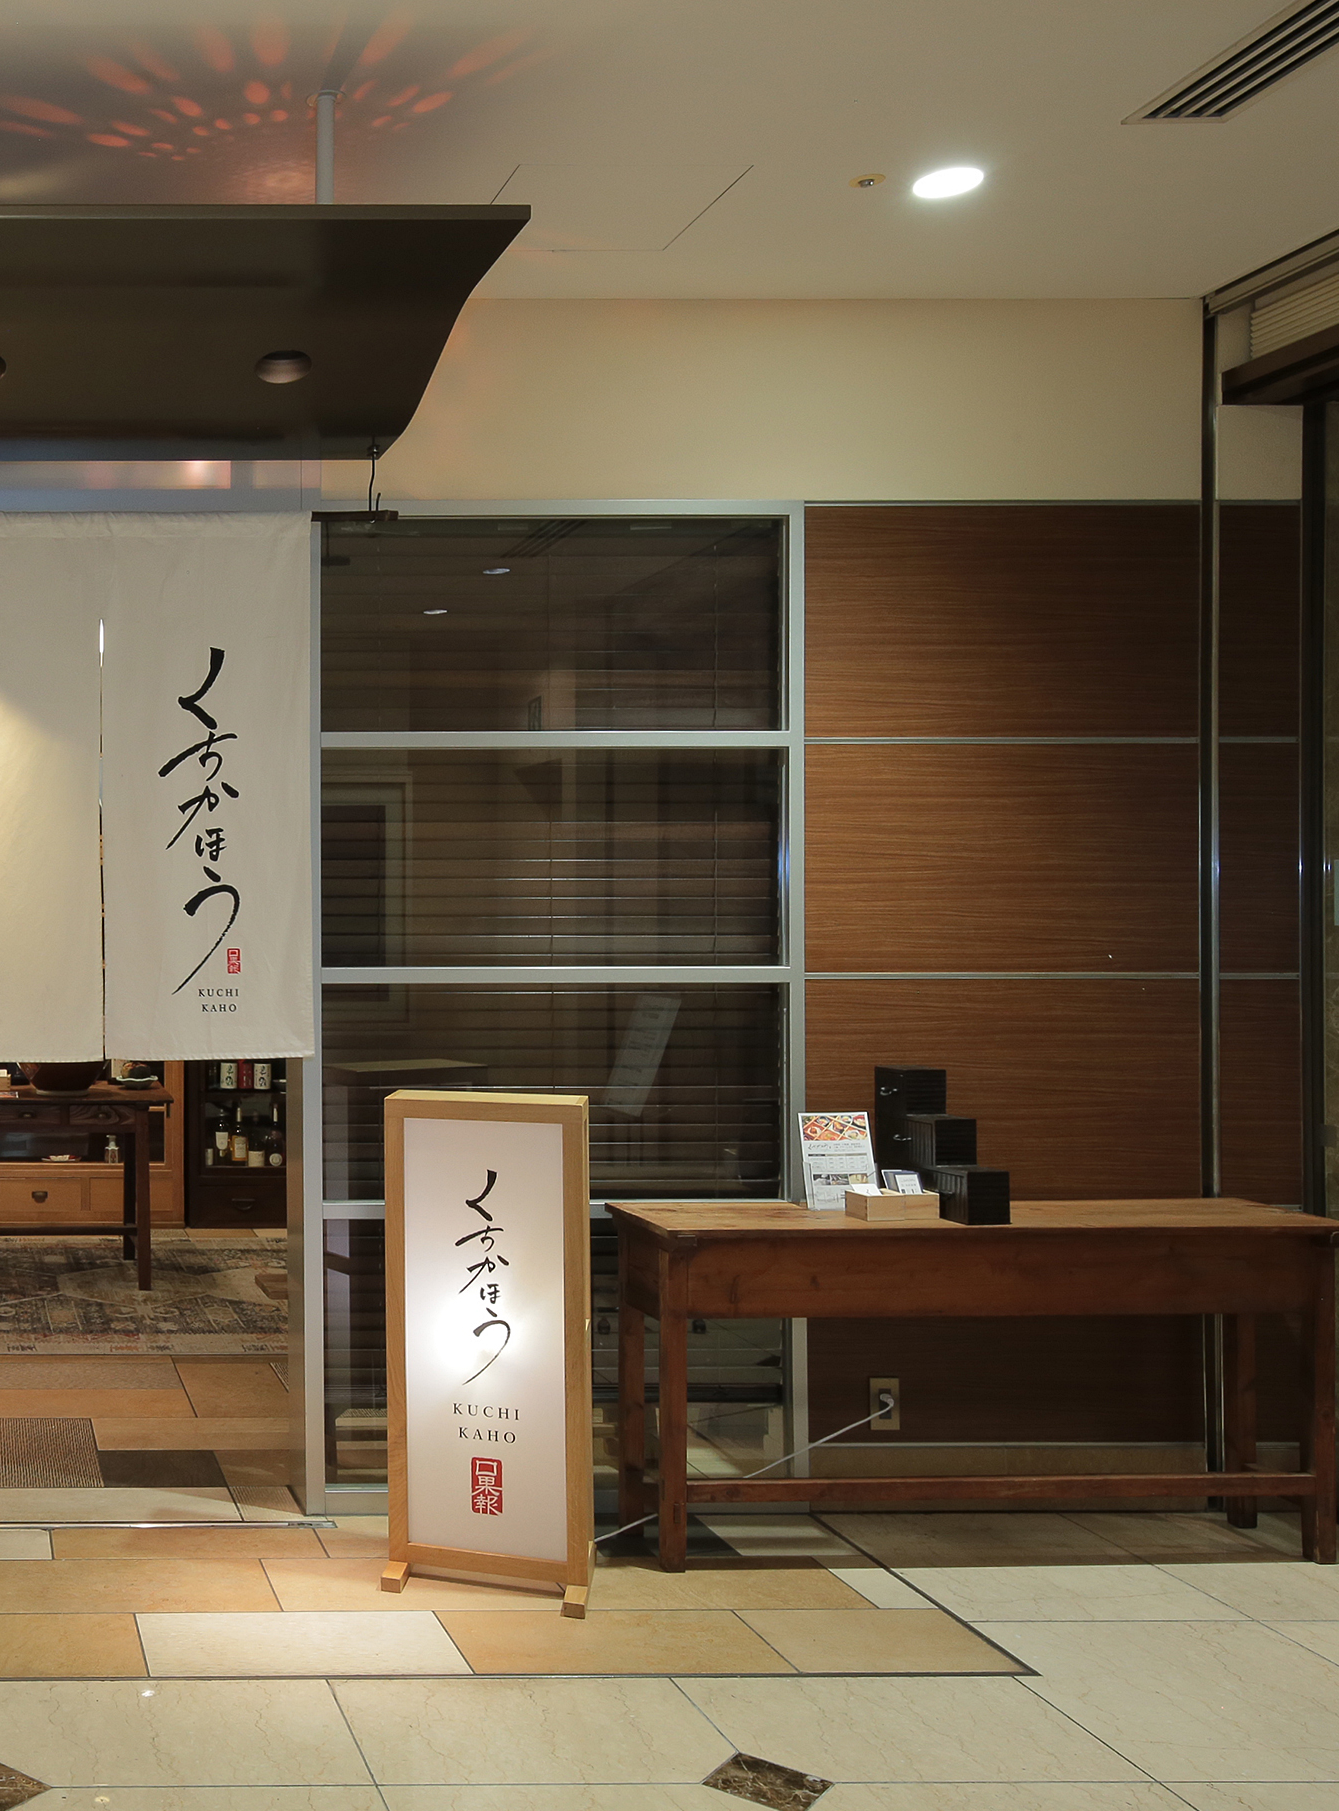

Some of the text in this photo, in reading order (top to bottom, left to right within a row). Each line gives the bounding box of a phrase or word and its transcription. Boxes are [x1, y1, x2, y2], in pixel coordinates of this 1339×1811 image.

[158, 646, 240, 995] くちかほう
[198, 988, 239, 997] KUCHI
[201, 1003, 237, 1013] KAHO
[454, 1169, 511, 1386] くちかほう
[453, 1403, 520, 1421] KUCHI
[459, 1426, 516, 1444] KAHO
[471, 1459, 503, 1516] 口果報
